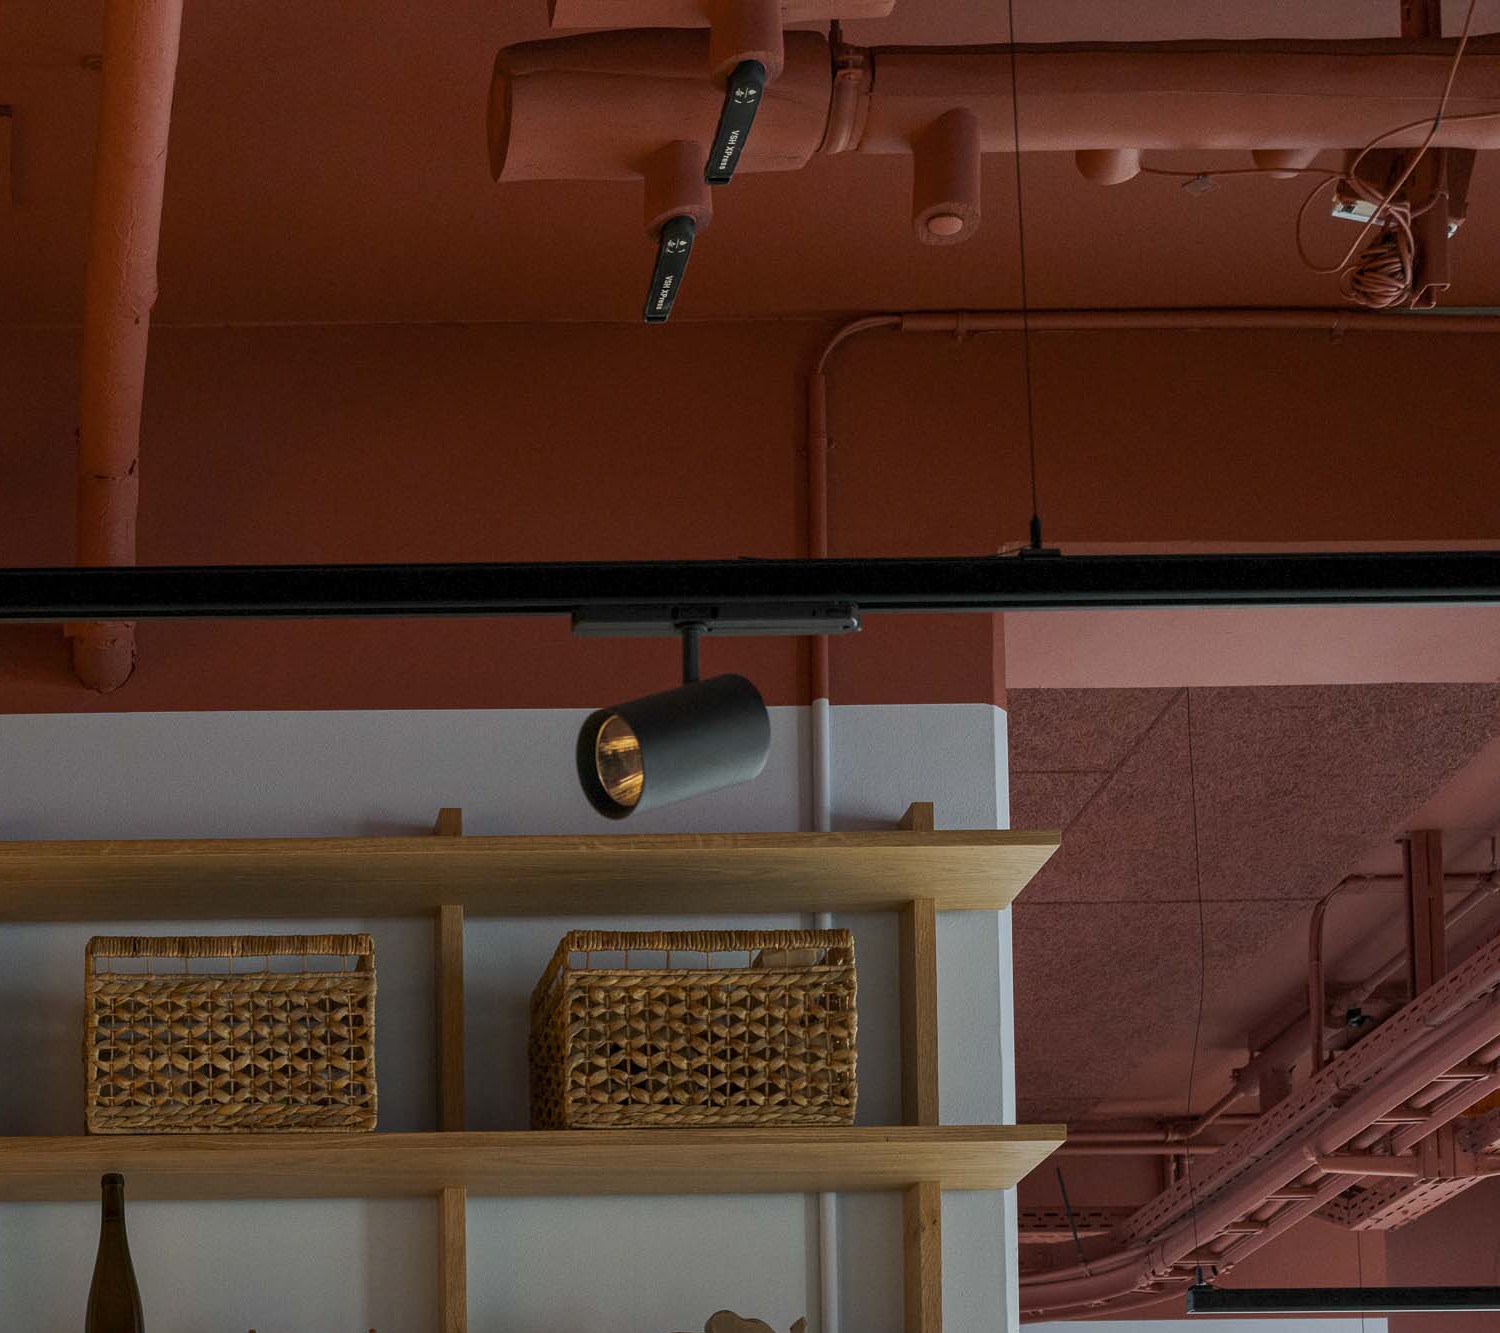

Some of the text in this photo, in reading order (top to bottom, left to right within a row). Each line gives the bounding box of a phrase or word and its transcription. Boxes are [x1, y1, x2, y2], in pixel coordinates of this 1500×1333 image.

[719, 130, 740, 170] VSH XPress
[663, 275, 673, 289] VSH
